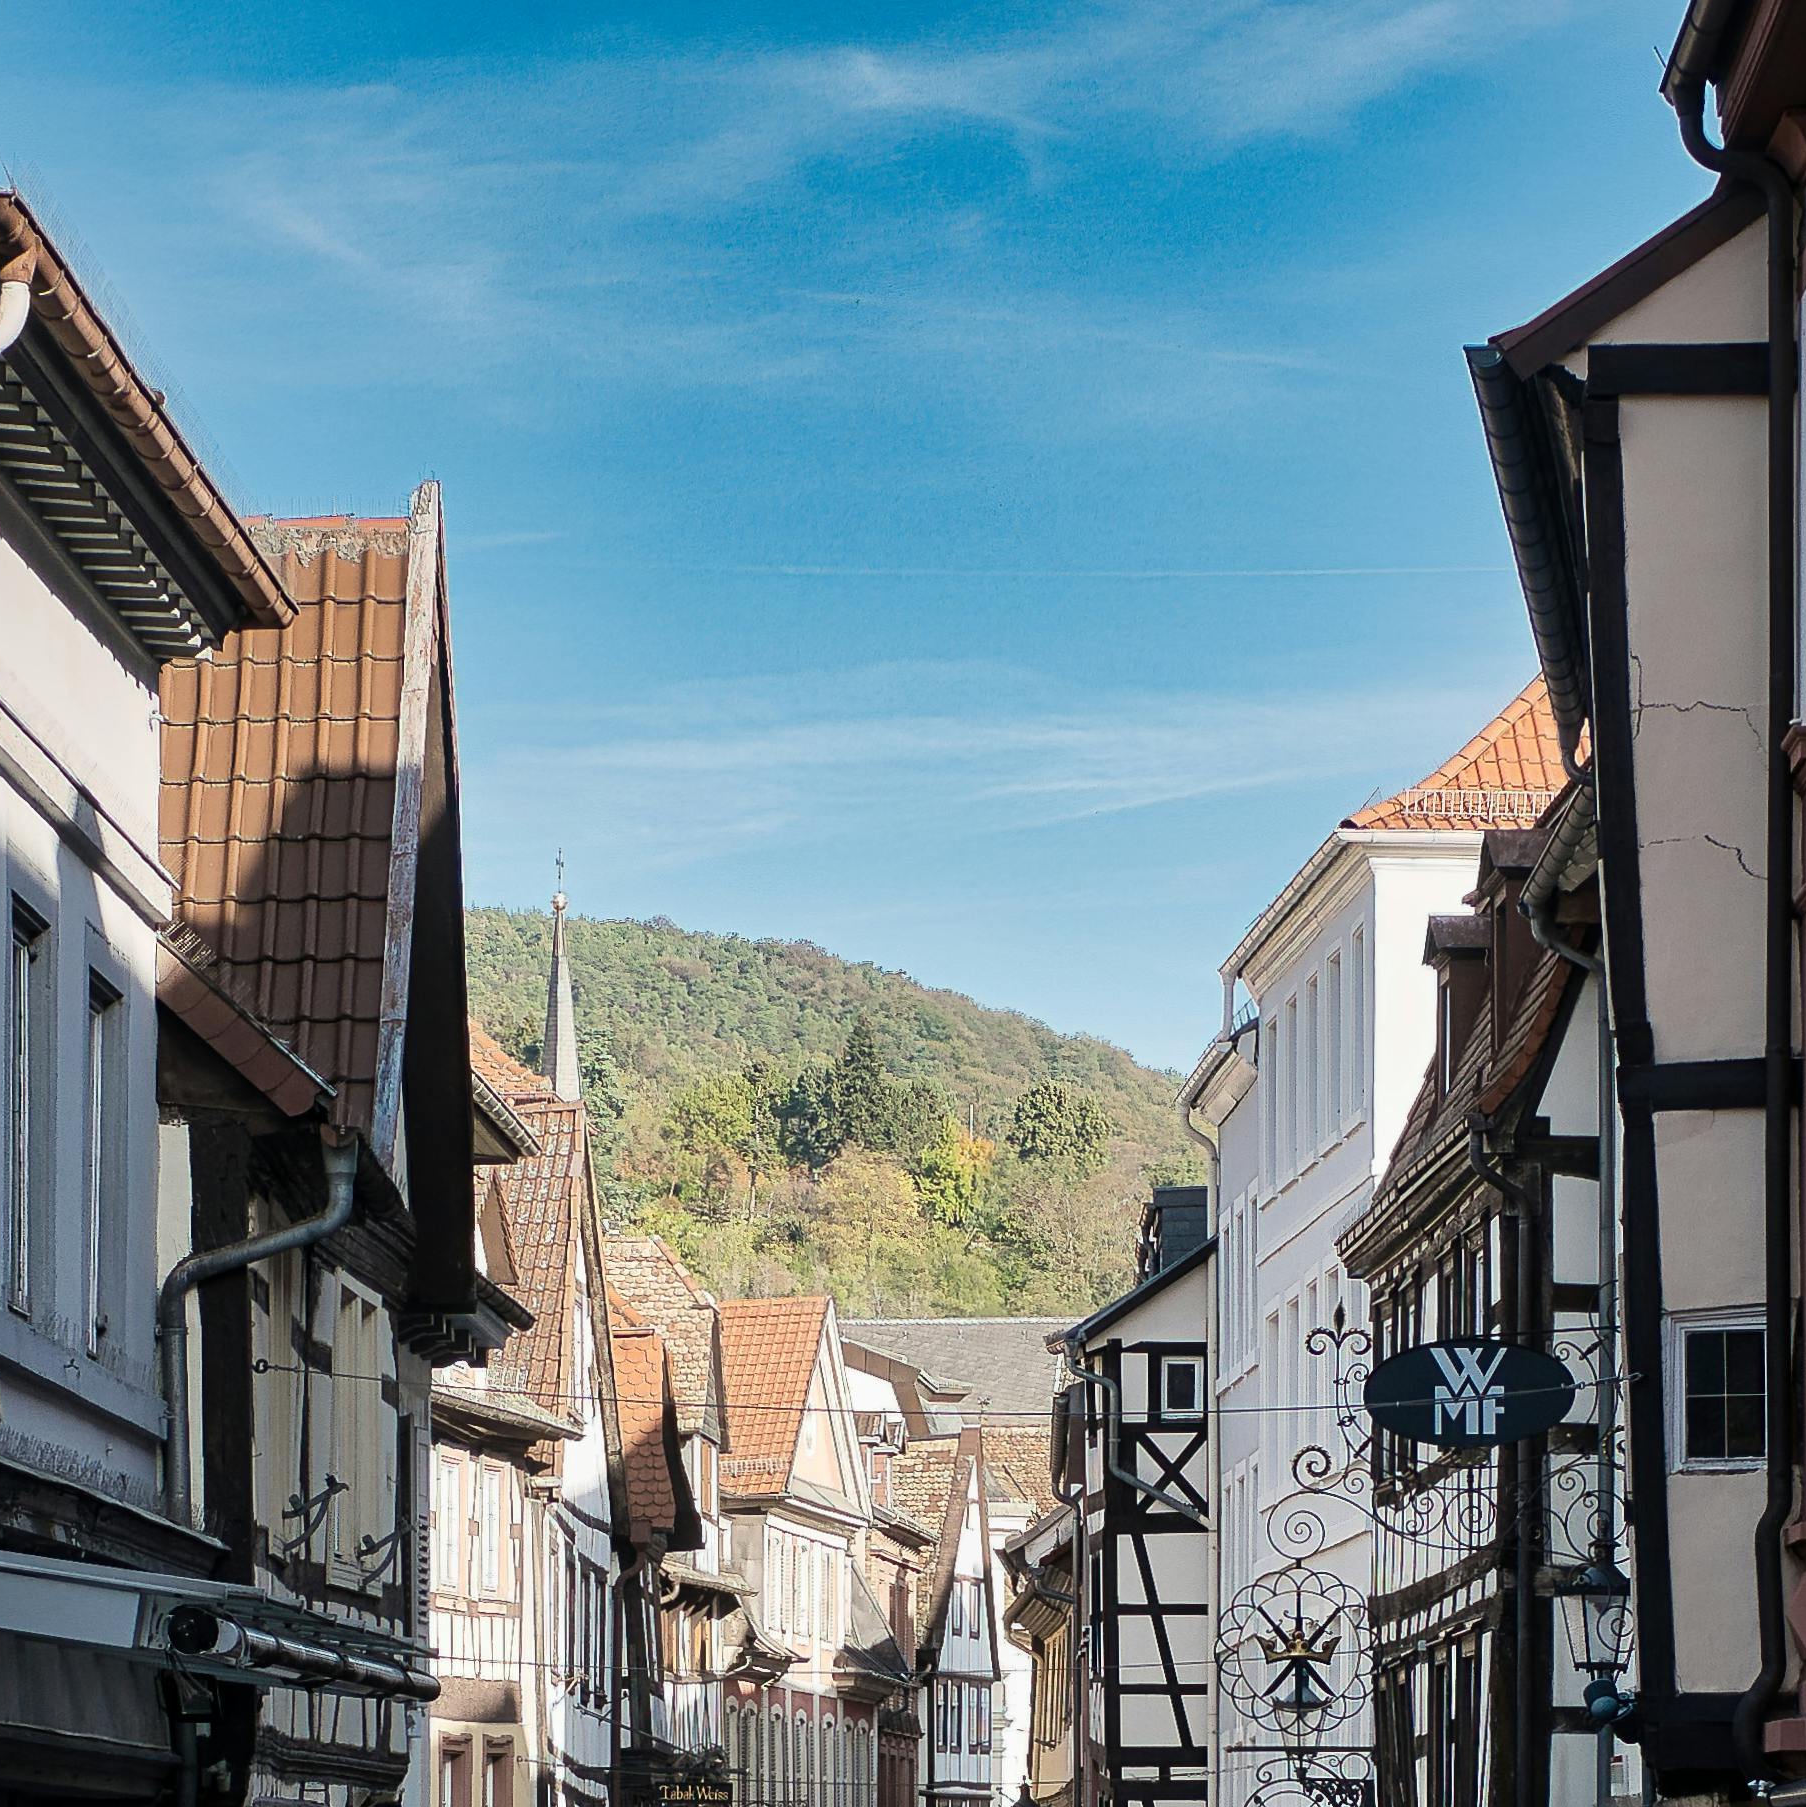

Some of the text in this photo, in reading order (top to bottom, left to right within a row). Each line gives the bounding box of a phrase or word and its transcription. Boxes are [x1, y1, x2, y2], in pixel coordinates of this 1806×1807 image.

[1429, 1346, 1508, 1436] WMF
[659, 1785, 729, 1801] Tabak Weiss
